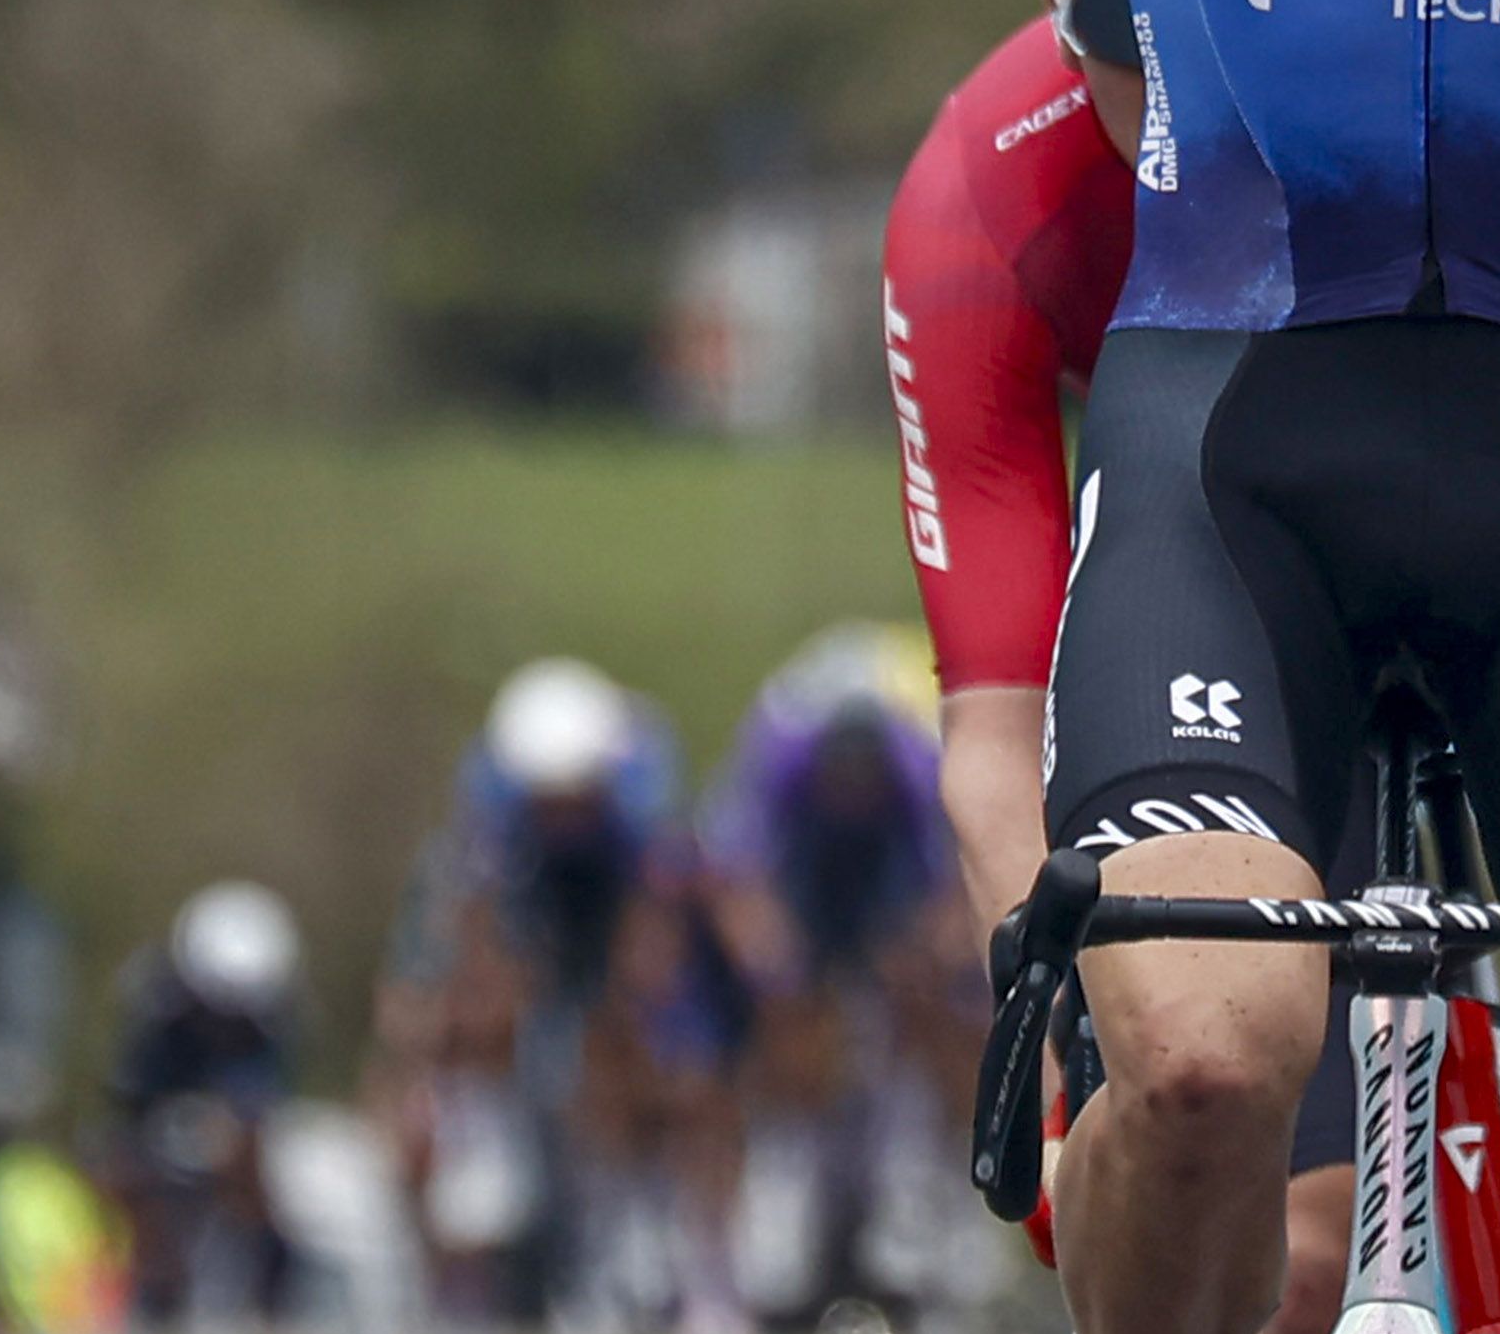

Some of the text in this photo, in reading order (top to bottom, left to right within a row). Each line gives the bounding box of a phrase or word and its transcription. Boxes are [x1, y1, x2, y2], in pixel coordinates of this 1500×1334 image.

[995, 86, 1087, 152] CADEX
[1160, 137, 1178, 192] DMG
[883, 277, 949, 571] GIANT
